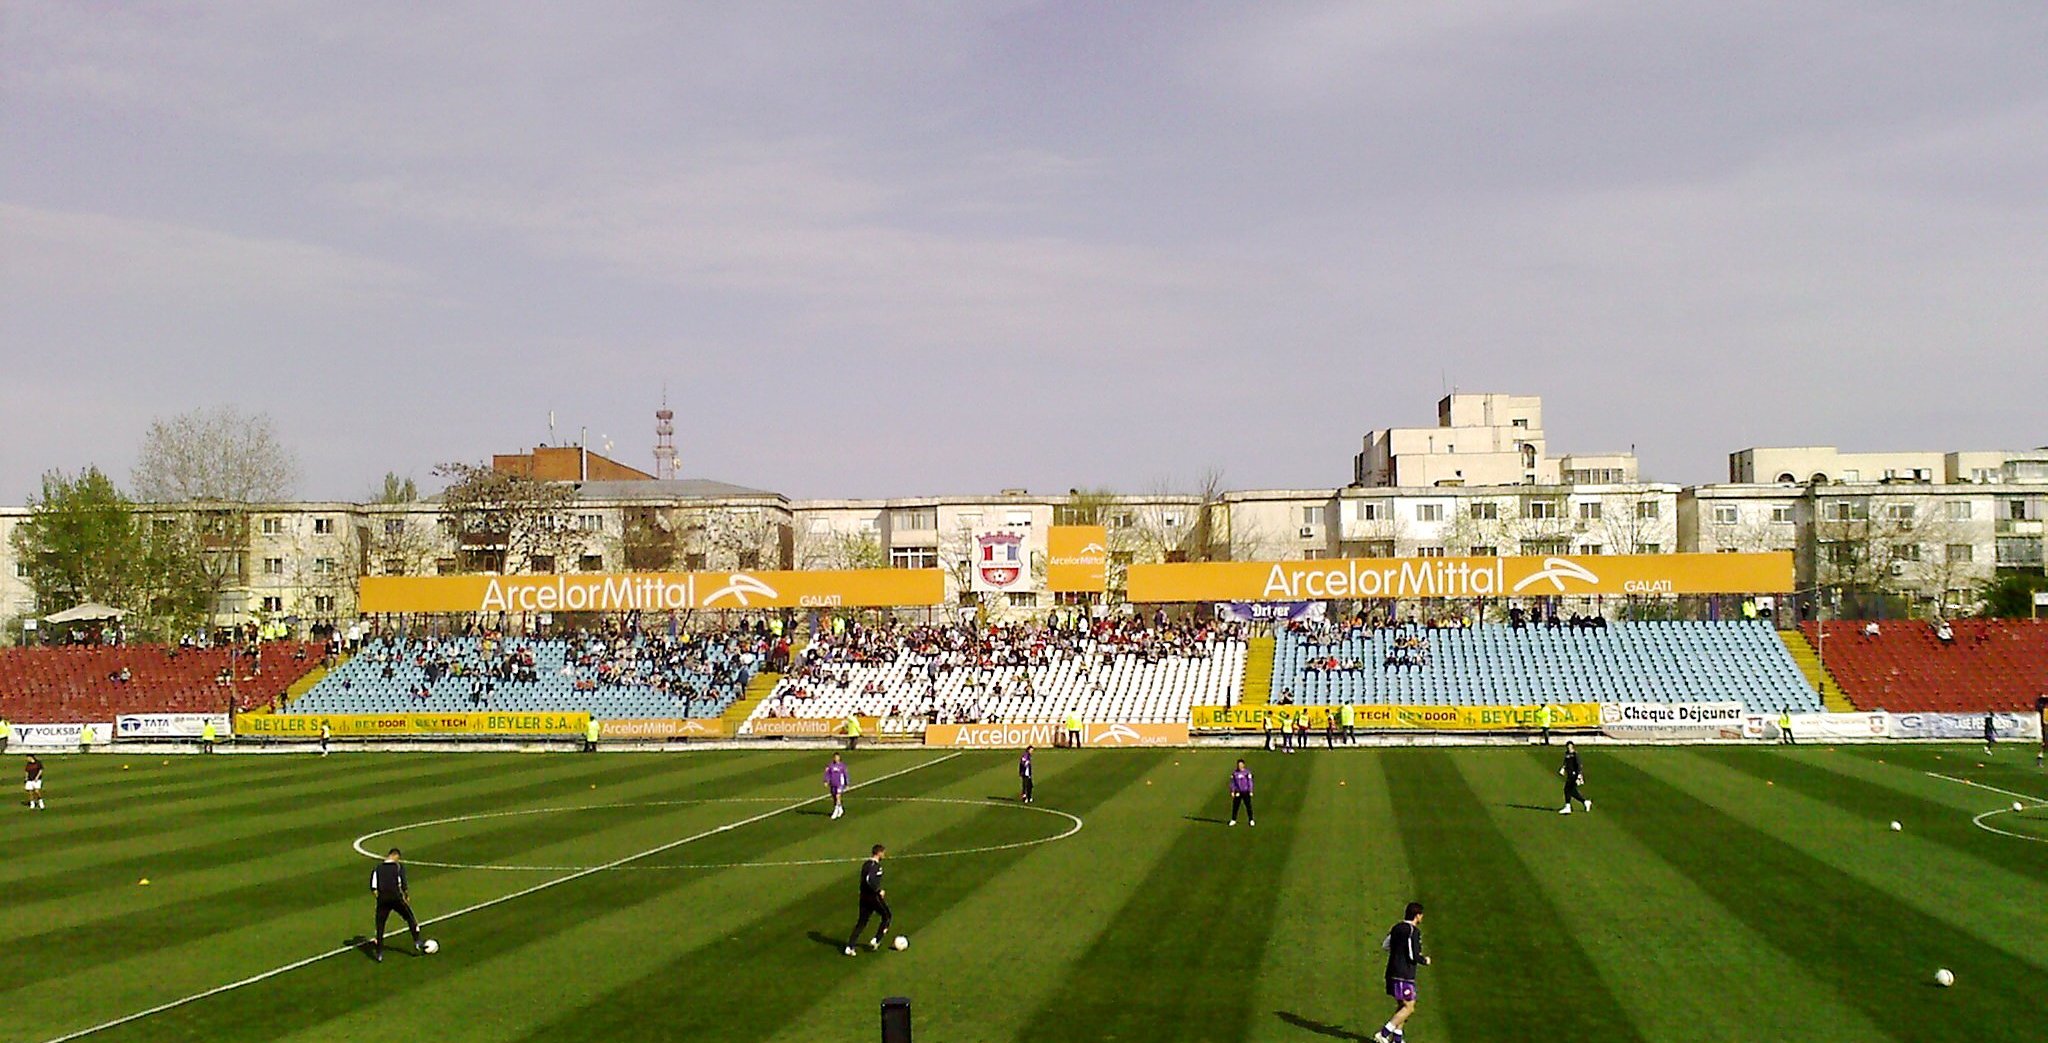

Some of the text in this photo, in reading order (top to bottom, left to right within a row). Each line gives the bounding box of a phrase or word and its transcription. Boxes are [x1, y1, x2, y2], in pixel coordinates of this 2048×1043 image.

[1051, 556, 1104, 565] ArcelorMittal
[1262, 558, 1672, 597] ArcelorMittal GALATI
[481, 575, 841, 610] ArcelorMittal GALATI
[1360, 711, 1390, 720] TECH
[1624, 705, 1742, 722] Chèque Déjeuner
[144, 719, 169, 727] TATA
[254, 719, 306, 731] BEYLER
[311, 719, 336, 731] SA.
[441, 719, 467, 727] TECH
[488, 716, 540, 729] BEYLER
[545, 716, 572, 729] S.A.
[602, 720, 677, 735] ArcelorMittal
[755, 719, 830, 734] ArcelorMittal
[35, 727, 98, 736] VOLKSBAK
[955, 724, 1089, 745] ArcelorMil
